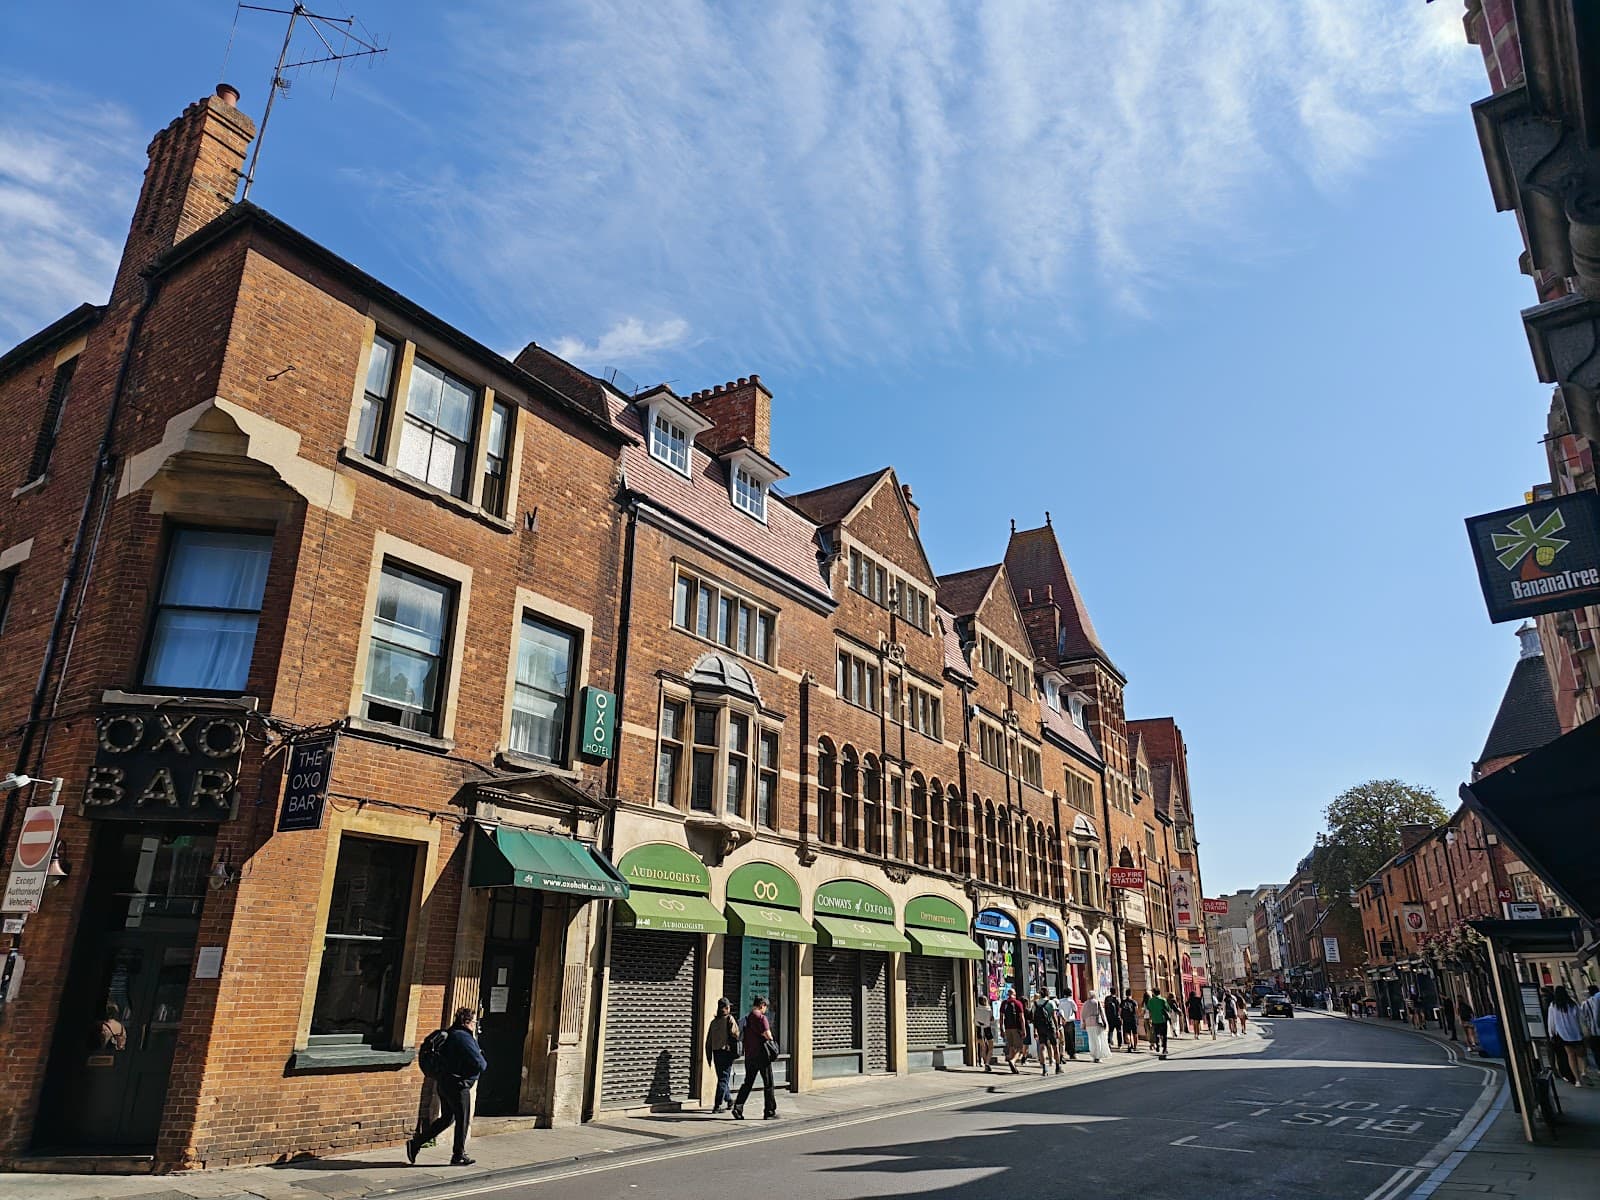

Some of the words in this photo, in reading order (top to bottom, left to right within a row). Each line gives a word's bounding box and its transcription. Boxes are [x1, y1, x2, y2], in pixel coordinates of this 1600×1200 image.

[1511, 568, 1600, 600] BananaTree
[100, 713, 244, 757] OXO
[300, 750, 323, 767] THE
[587, 743, 609, 756] HOTEL
[84, 767, 233, 808] BAR
[292, 772, 321, 790] OXO
[289, 794, 316, 812] BAR
[15, 876, 36, 885] Except
[631, 864, 701, 884] AUDIOLOGISTS
[817, 894, 852, 910] CONWAYS
[864, 902, 893, 916] OXFORD
[1281, 1112, 1424, 1134] BUS
